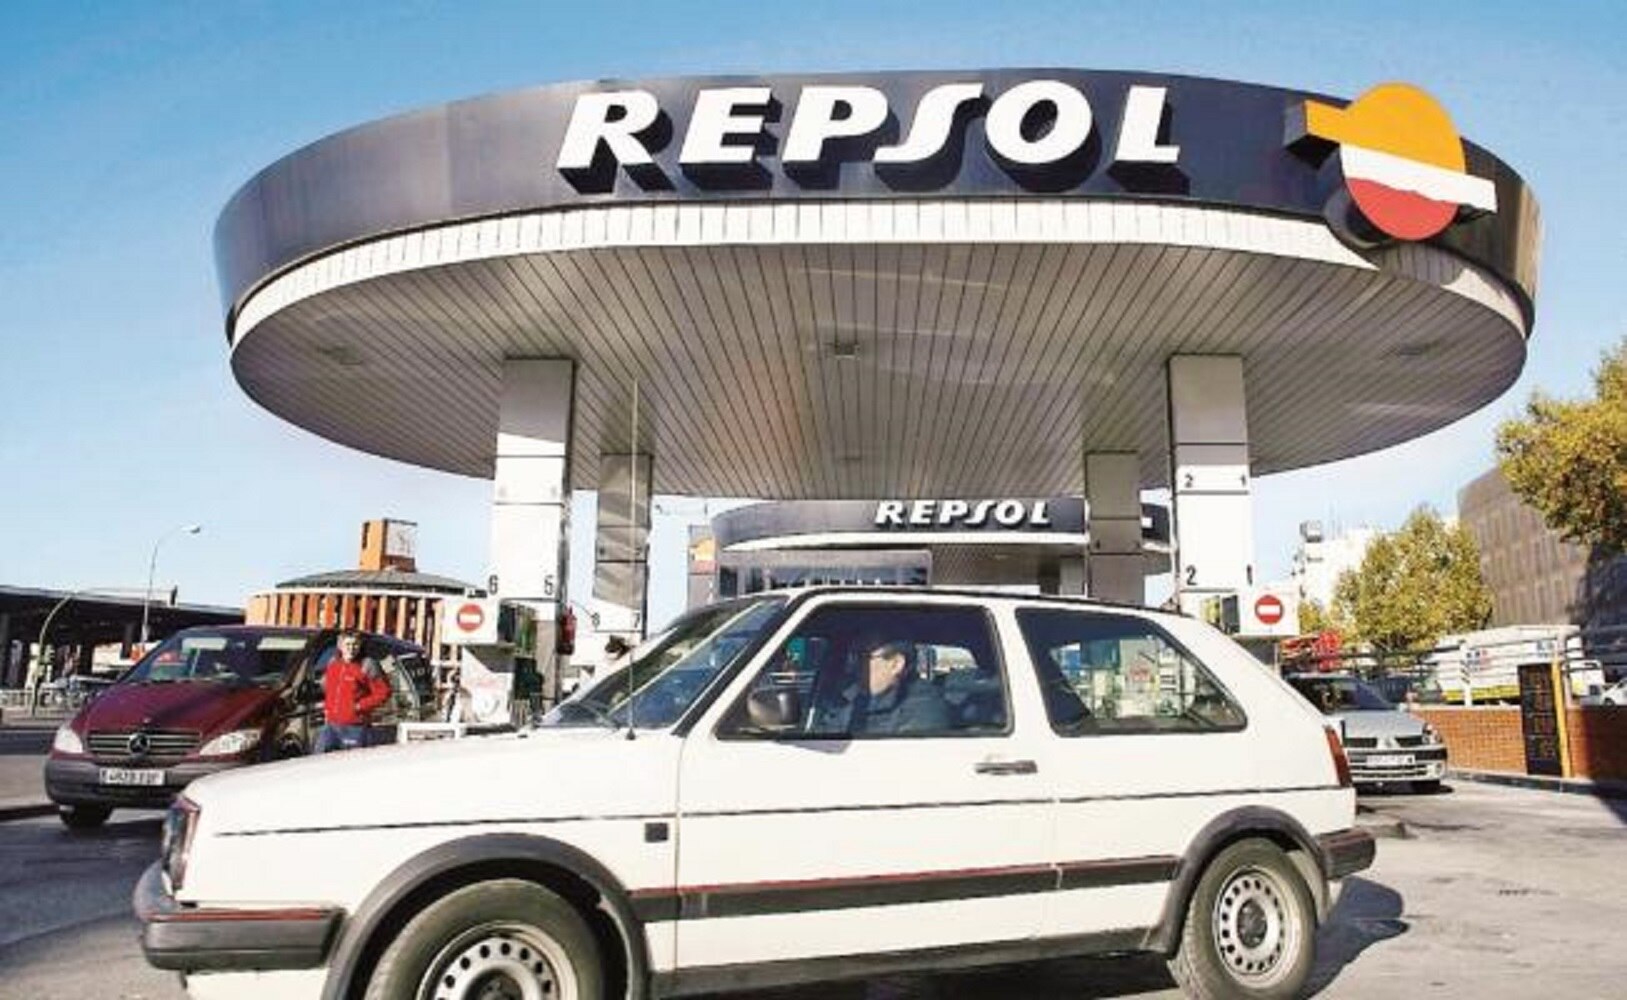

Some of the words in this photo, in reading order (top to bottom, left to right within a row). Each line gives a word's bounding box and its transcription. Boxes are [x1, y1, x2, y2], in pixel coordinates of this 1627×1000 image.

[556, 80, 1181, 170] REPSOL
[1185, 474, 1194, 487] 2
[875, 499, 1051, 527] REPSOL
[489, 575, 498, 595] 6
[544, 575, 554, 594] 5
[1187, 566, 1197, 586] 2
[1246, 565, 1253, 585] 1
